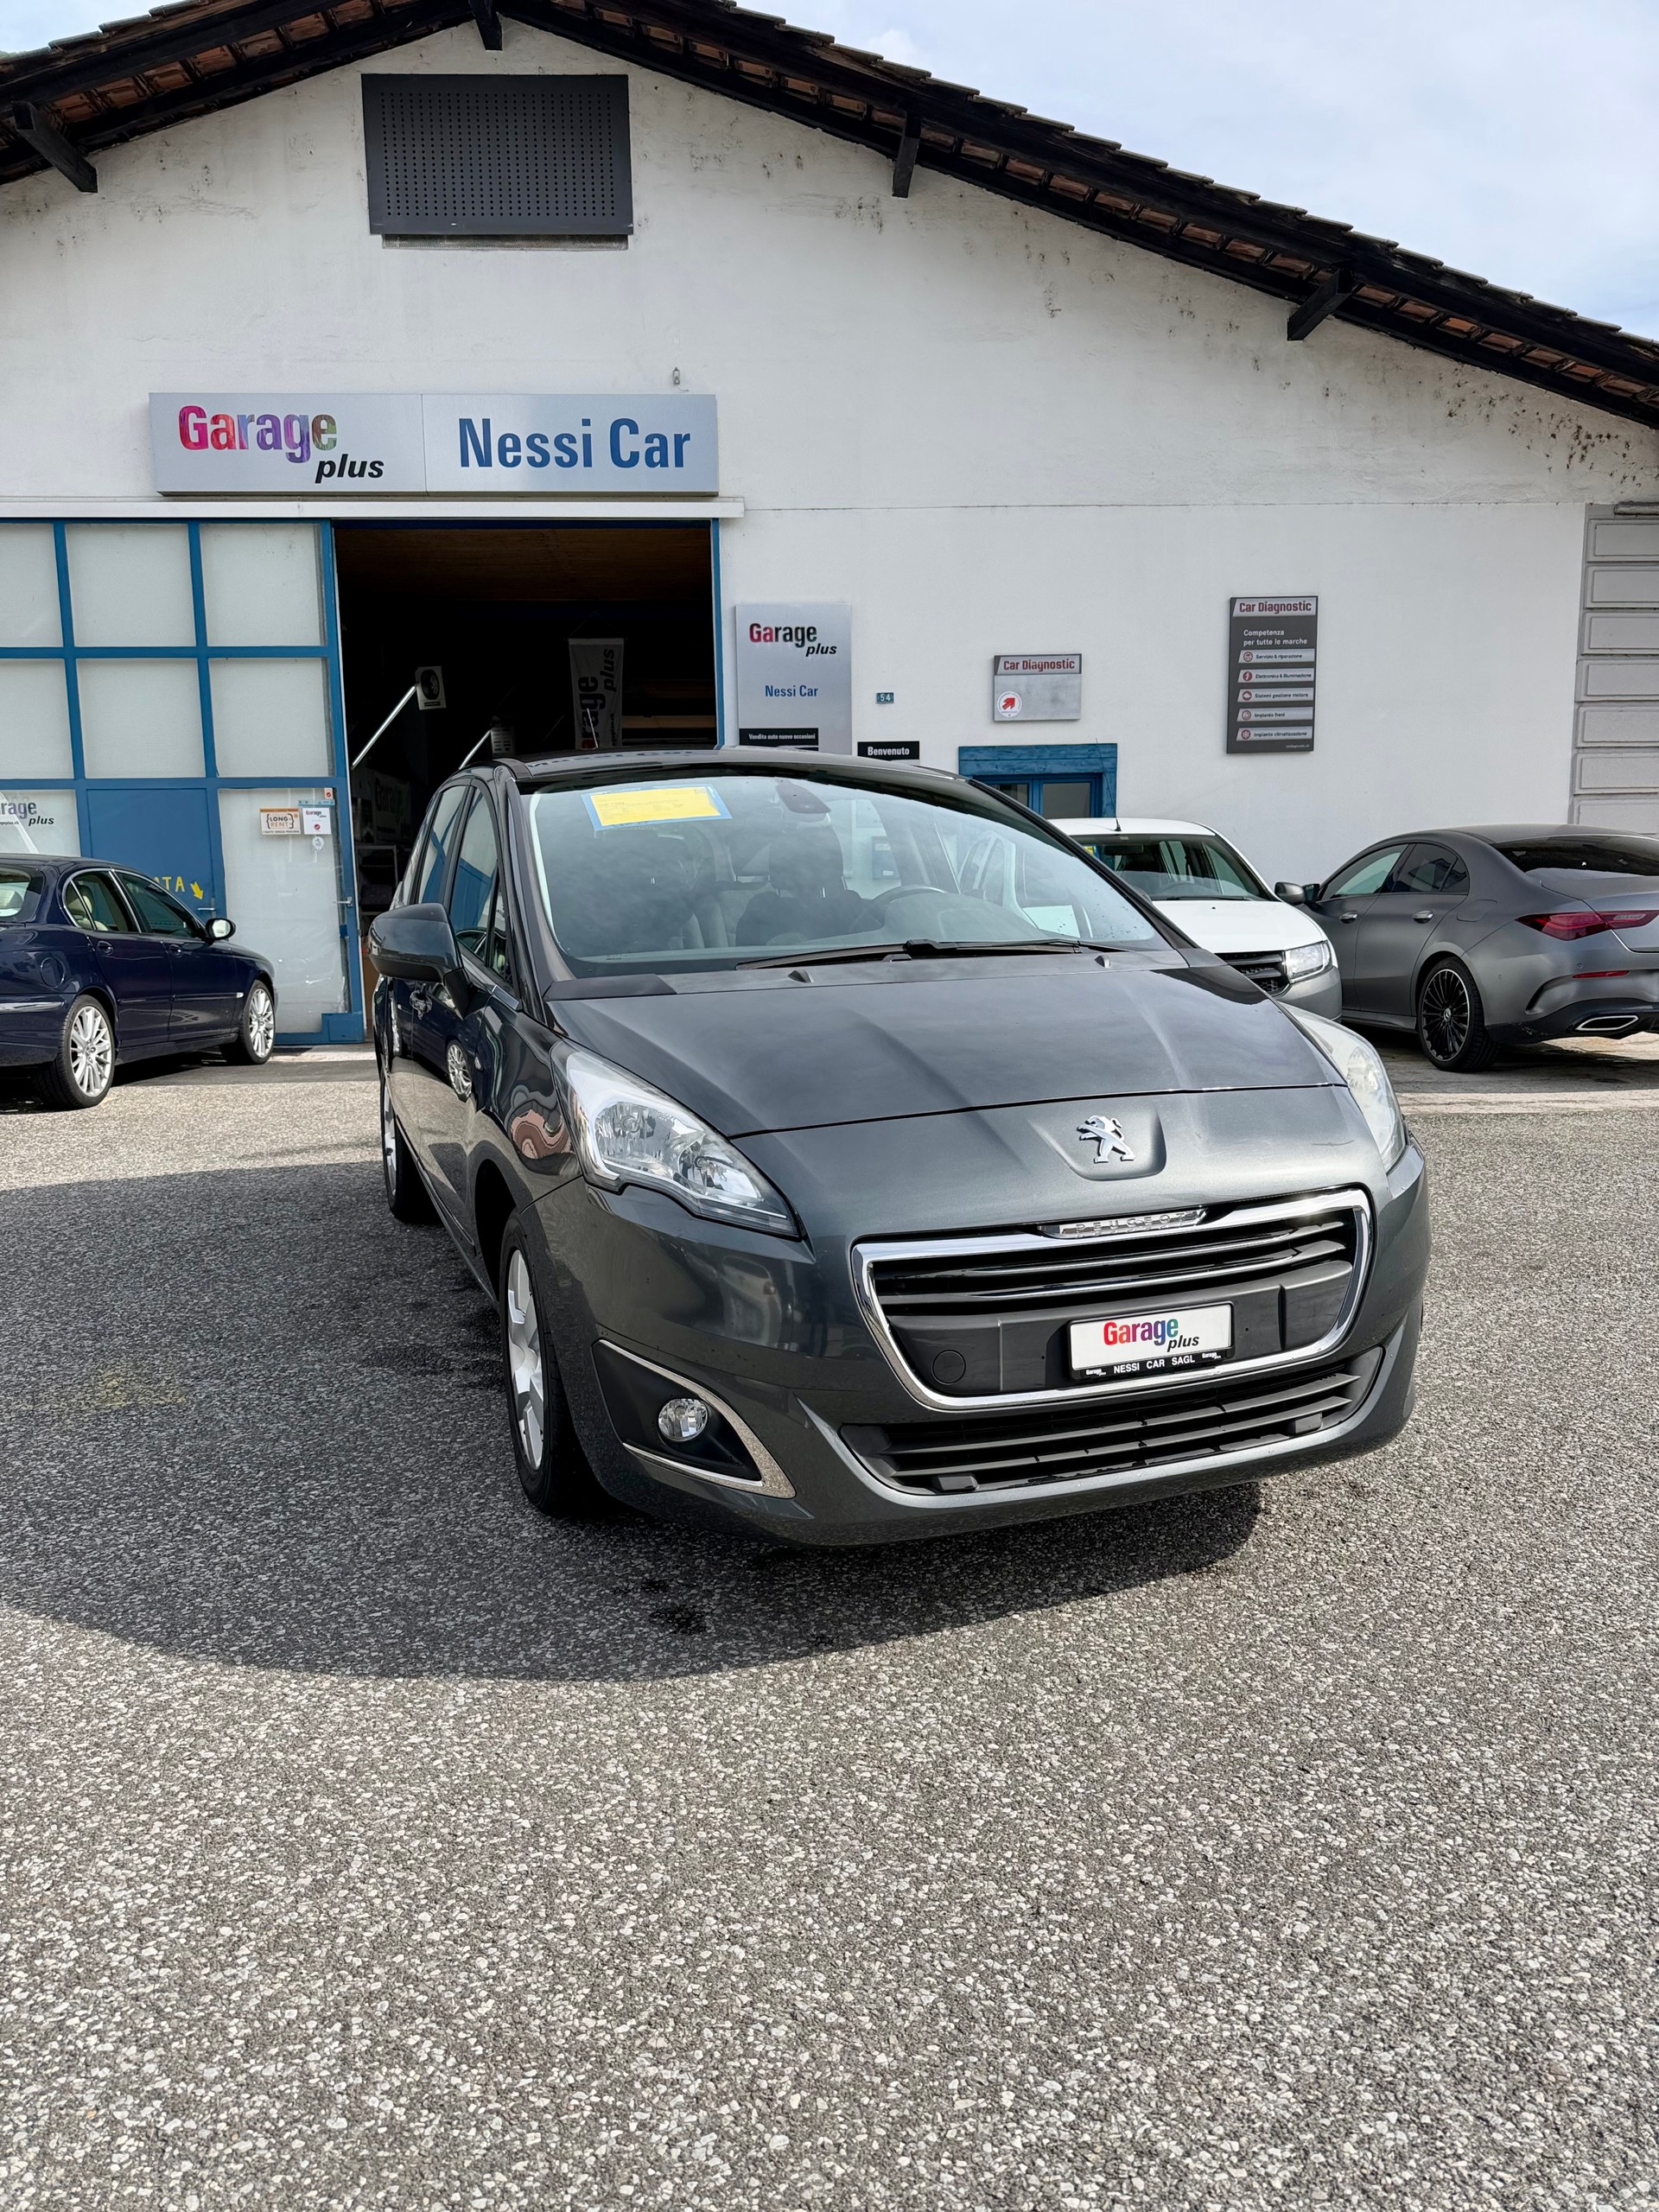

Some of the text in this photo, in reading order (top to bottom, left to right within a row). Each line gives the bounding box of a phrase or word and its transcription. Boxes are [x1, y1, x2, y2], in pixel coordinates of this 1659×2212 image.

[179, 404, 338, 463] Garage
[459, 418, 690, 468] Nessi Car
[315, 454, 385, 484] plus
[1239, 601, 1312, 614] Car Diagnostic
[749, 623, 817, 648] Garage
[805, 643, 837, 657] plus
[601, 648, 617, 692] plus
[1003, 658, 1075, 671] Car Diagnostic
[765, 685, 818, 697] Nessi Car
[880, 693, 891, 702] 54
[868, 747, 910, 756] Benvenuto
[29, 816, 54, 826] plus
[1076, 1212, 1186, 1237] PEUGEOT
[1103, 1318, 1179, 1346] Garage
[1166, 1335, 1199, 1352] plus
[1114, 1362, 1140, 1374] NESSI
[1146, 1359, 1165, 1370] CAR
[1171, 1355, 1196, 1366] SAGL
